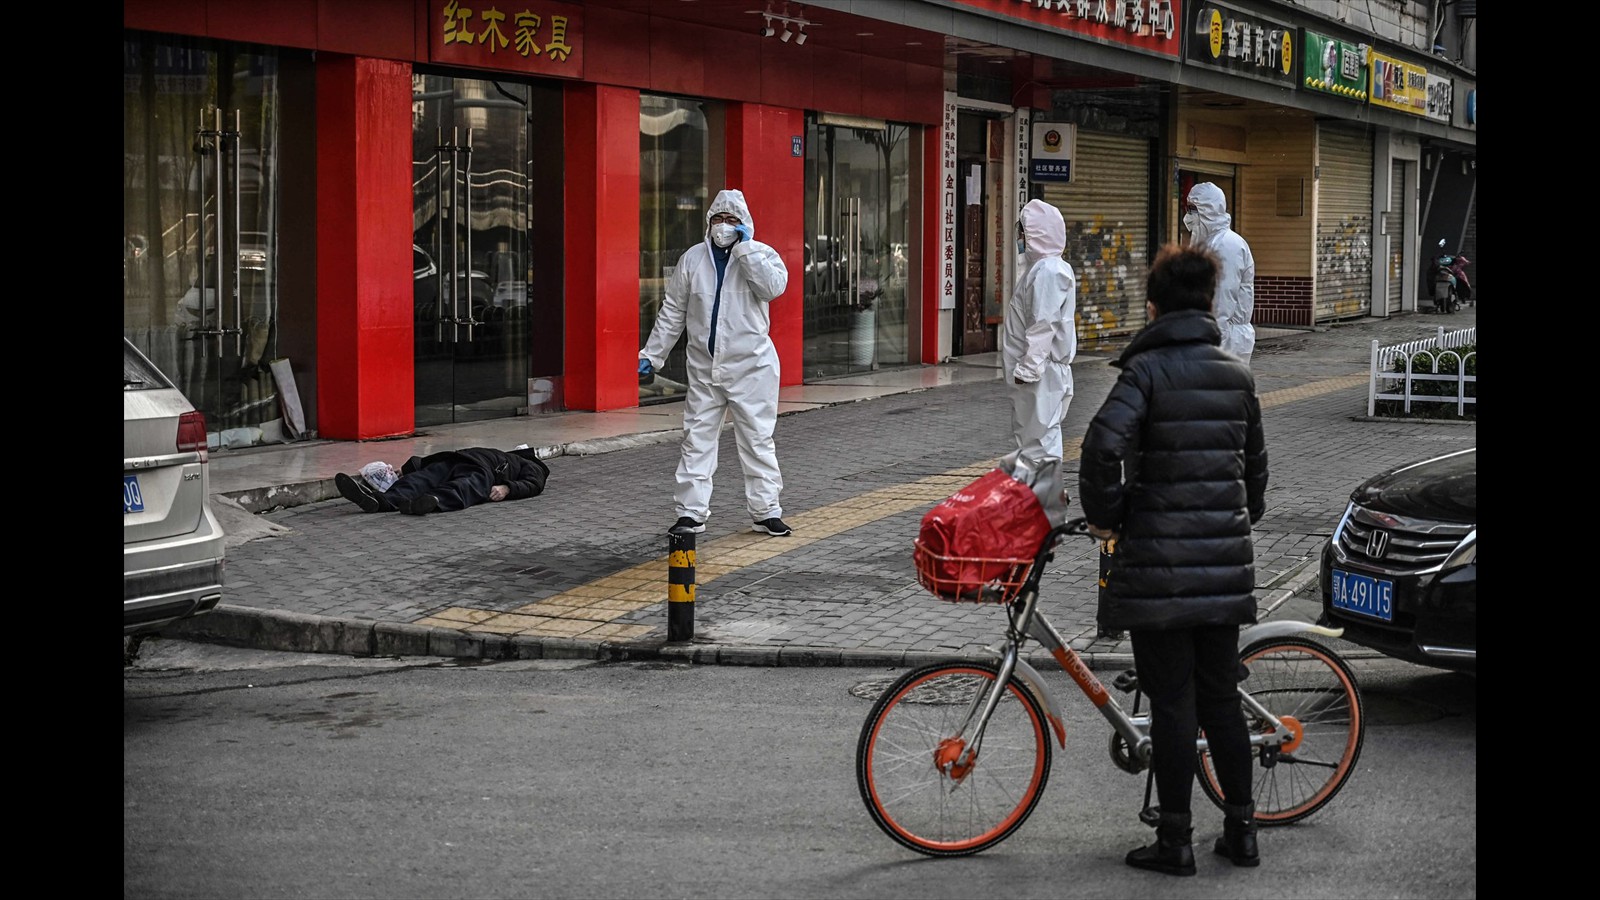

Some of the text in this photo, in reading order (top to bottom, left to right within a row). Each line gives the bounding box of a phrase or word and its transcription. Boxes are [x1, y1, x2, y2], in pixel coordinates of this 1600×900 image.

[443, 0, 572, 62] 红木家具
[1035, 164, 1067, 172] 社区警务室
[945, 173, 954, 297] 金门社区委员会
